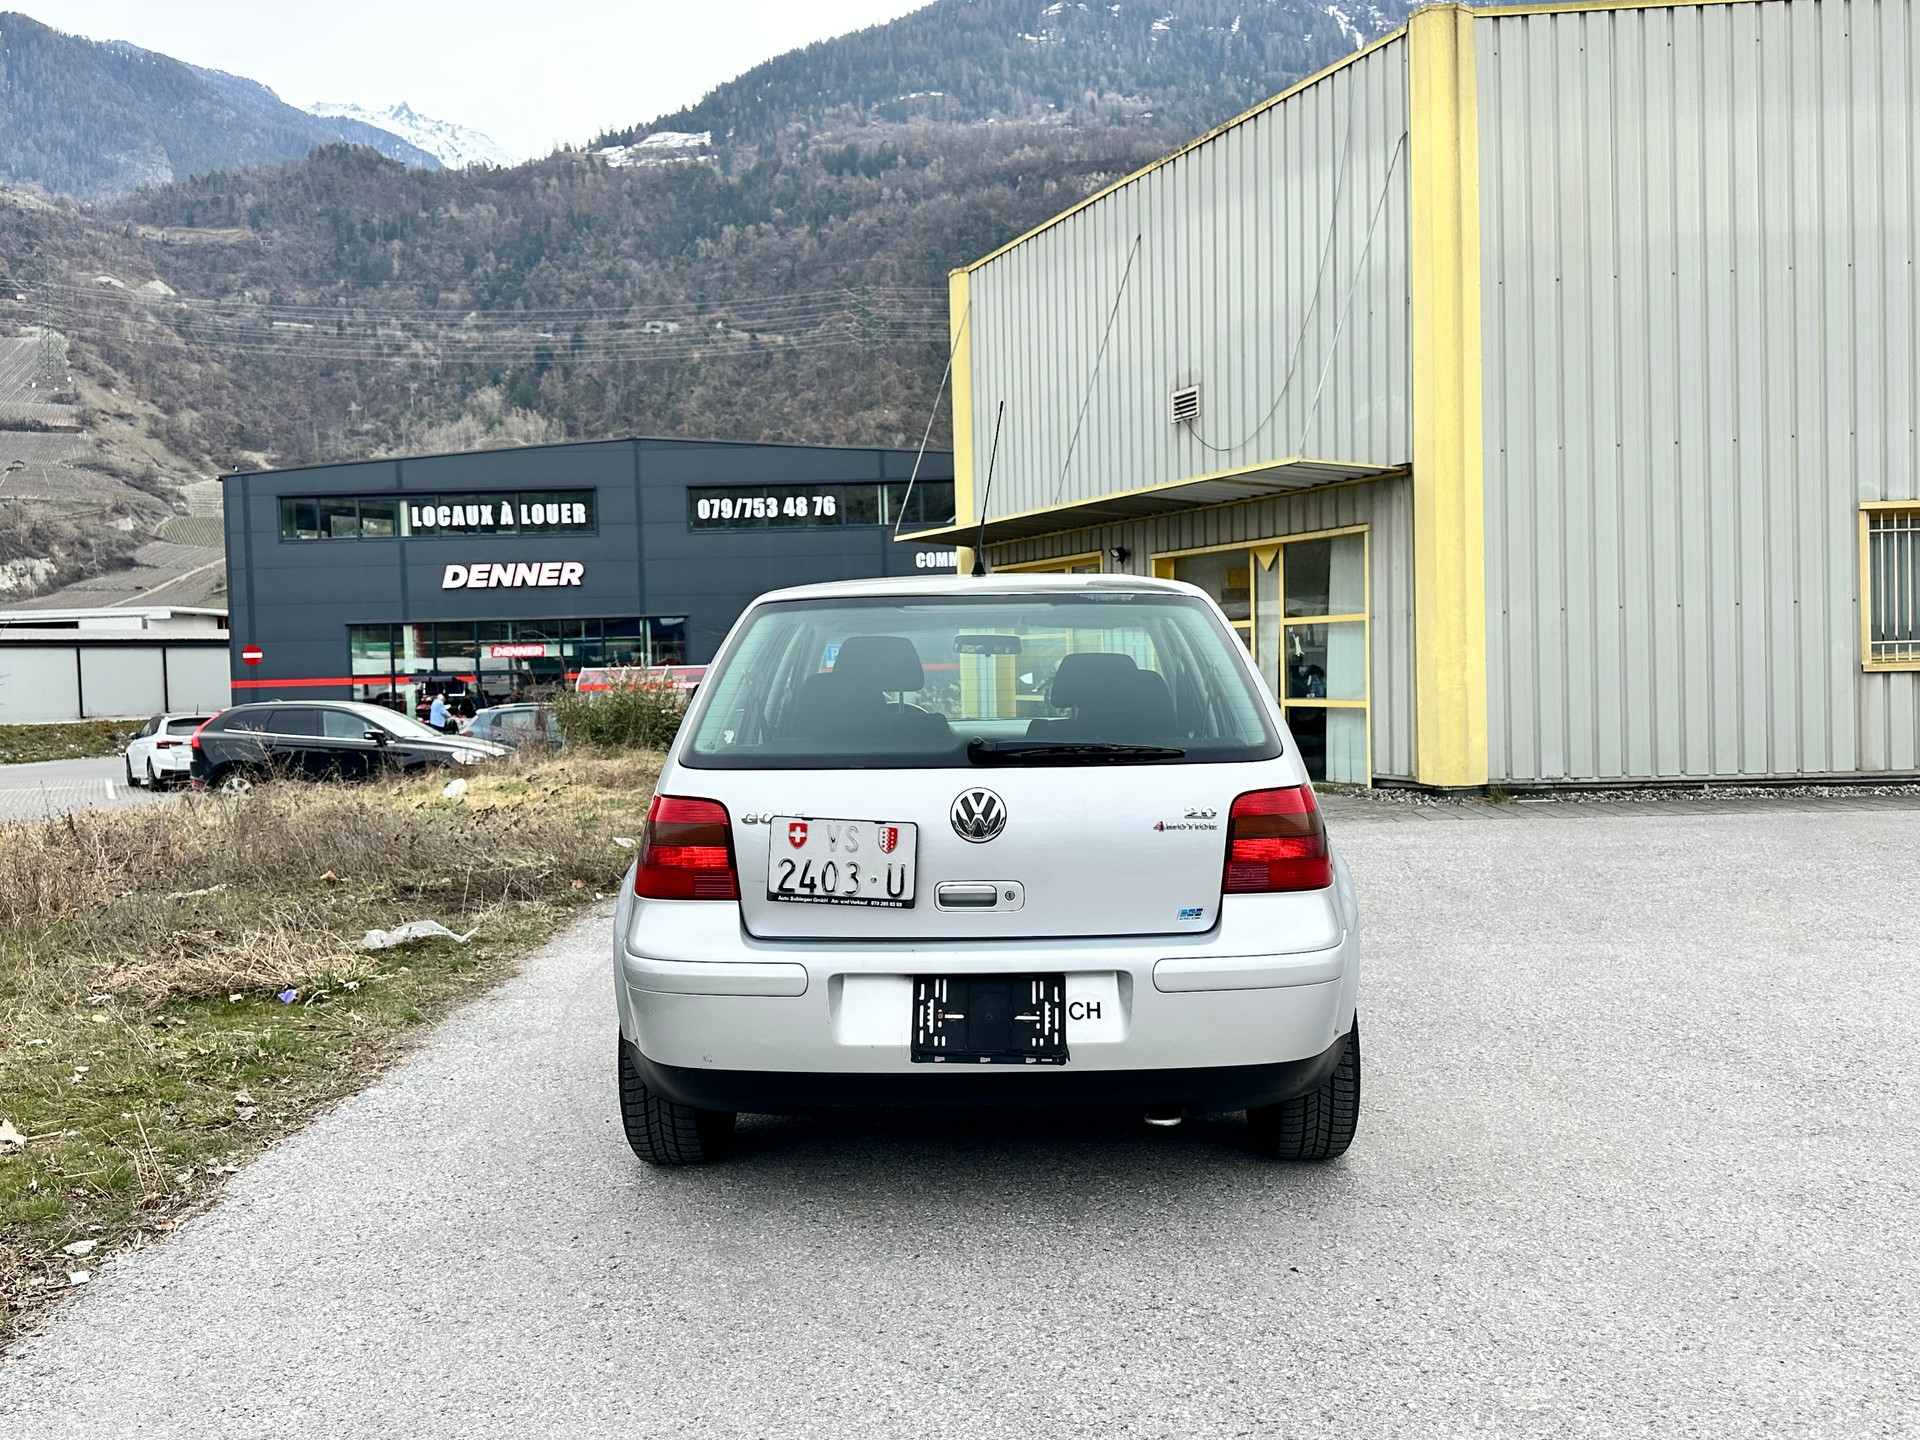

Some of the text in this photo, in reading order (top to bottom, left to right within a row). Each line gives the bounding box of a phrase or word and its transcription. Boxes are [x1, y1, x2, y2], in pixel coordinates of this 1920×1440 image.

[411, 501, 586, 528] LOCAUX À LOUER
[697, 495, 836, 520] 079/753 48 76
[442, 562, 585, 589] DENNER
[492, 646, 544, 657] DENNER
[826, 824, 860, 853] VS
[1068, 1001, 1102, 1020] CH
